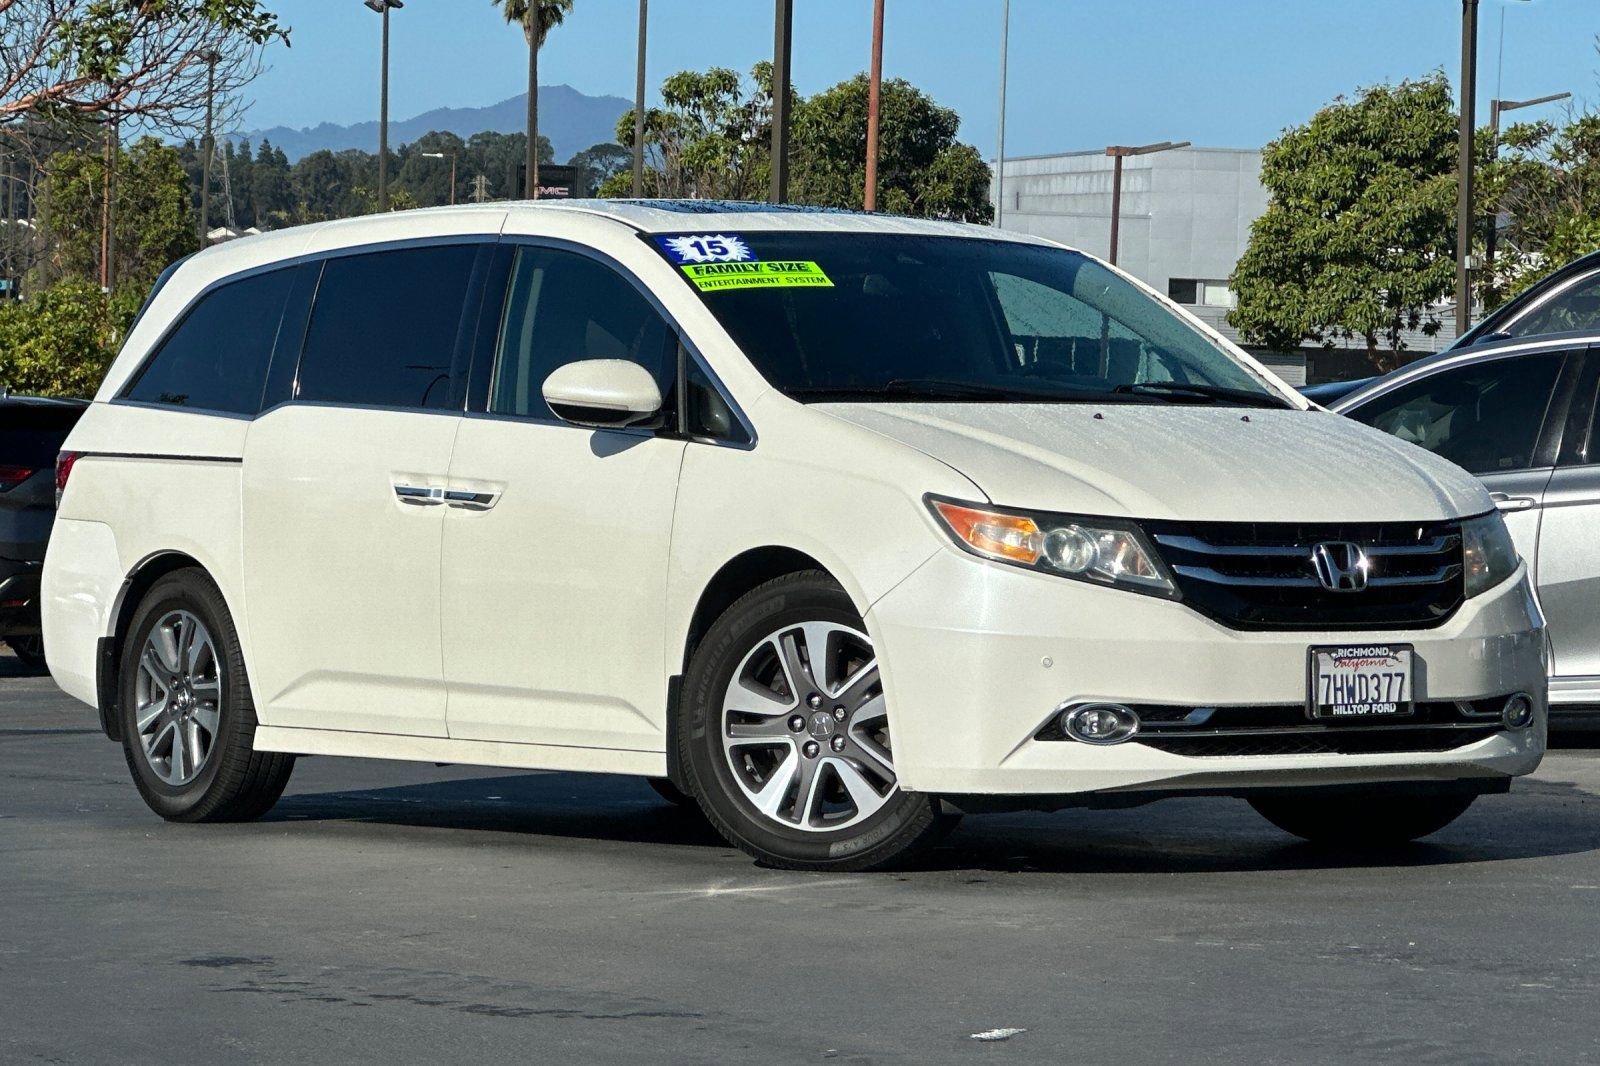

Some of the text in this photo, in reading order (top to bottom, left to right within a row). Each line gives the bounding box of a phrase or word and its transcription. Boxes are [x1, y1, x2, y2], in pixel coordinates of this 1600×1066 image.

[536, 186, 569, 196] MC
[690, 240, 729, 256] 15
[693, 261, 810, 277] FAMILY SIZE
[698, 276, 827, 289] ENTERTAINMENT SYSTEM
[1337, 647, 1389, 657] RICHMOND
[1333, 658, 1394, 672] California
[1320, 672, 1405, 705] 7HWD377
[1332, 703, 1397, 715] HILLTOP FORD
